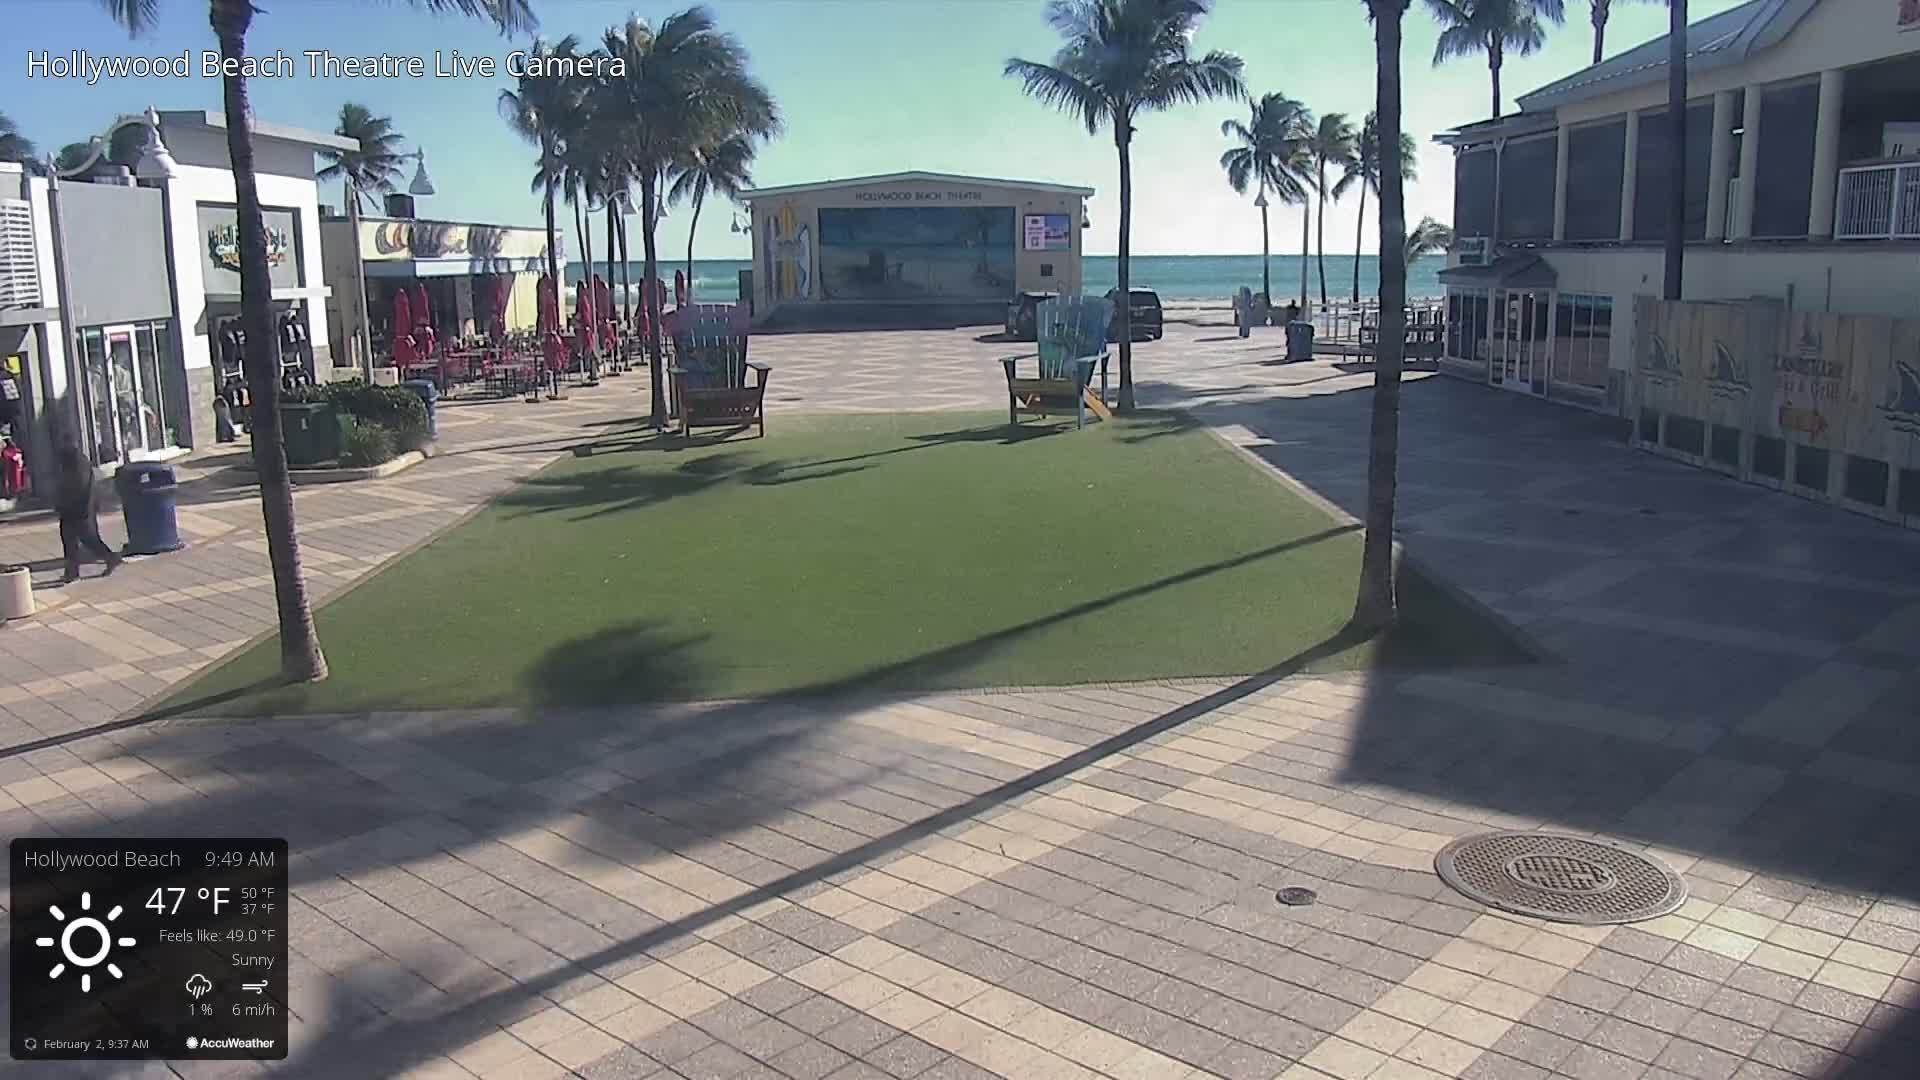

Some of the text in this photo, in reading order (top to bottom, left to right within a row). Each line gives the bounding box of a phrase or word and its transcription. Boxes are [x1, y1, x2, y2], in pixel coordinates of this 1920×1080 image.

[855, 191, 982, 201] HOLLYWOOD BEACH THEATRE
